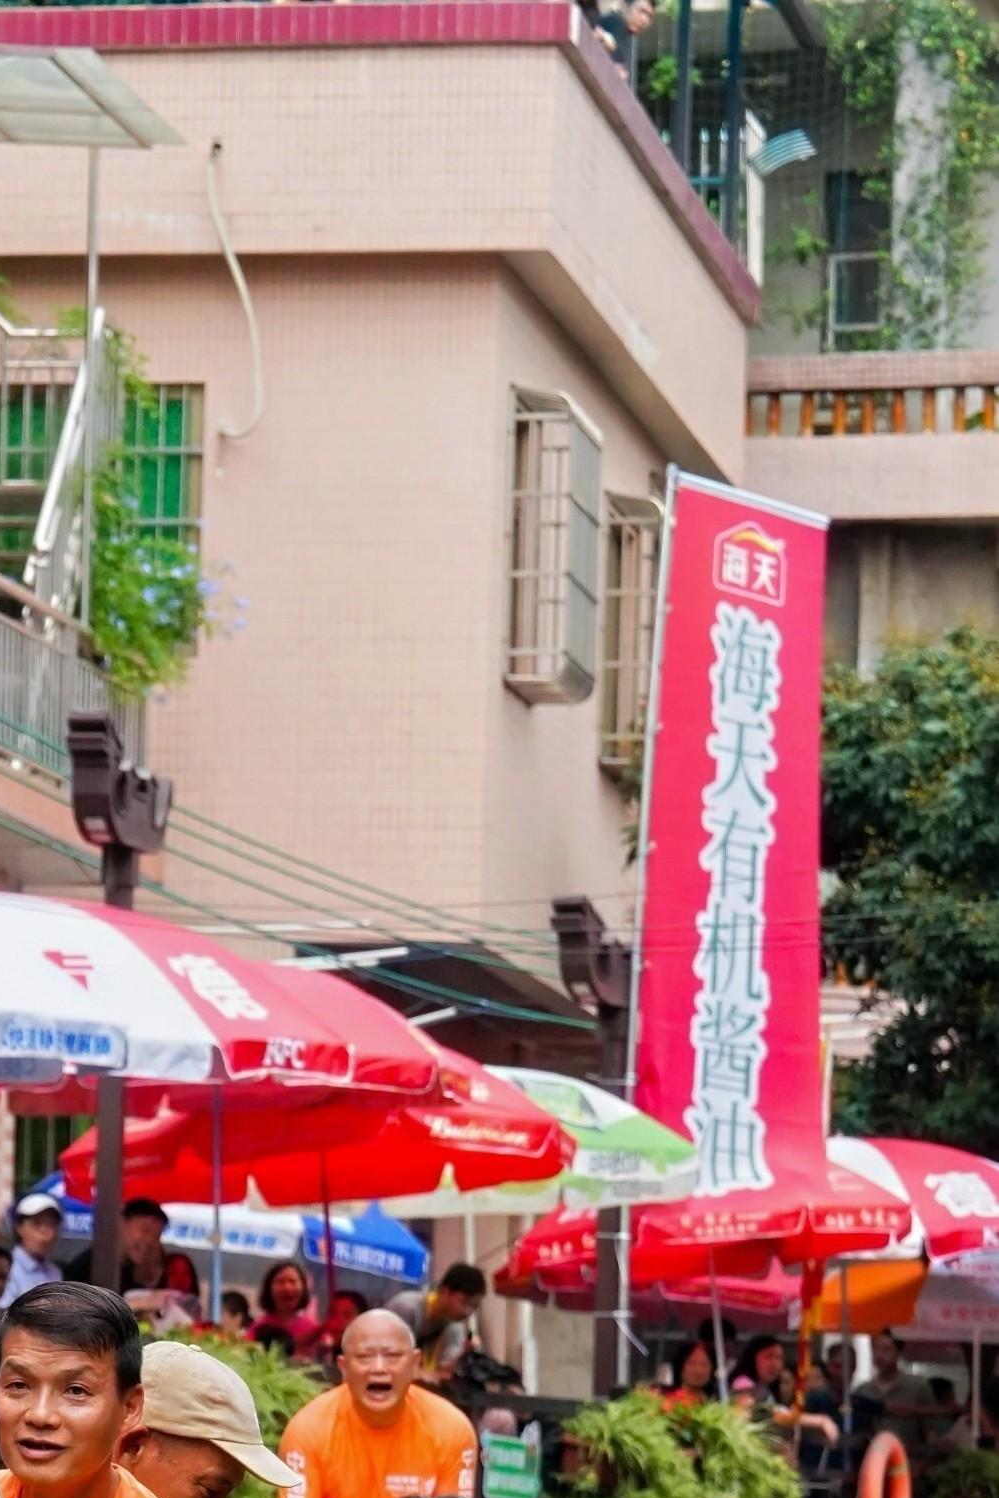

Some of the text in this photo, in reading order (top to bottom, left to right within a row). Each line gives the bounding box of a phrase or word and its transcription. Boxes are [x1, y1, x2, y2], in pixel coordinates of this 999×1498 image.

[721, 543, 779, 597] 海天
[698, 610, 774, 1190] 海天有机酱油
